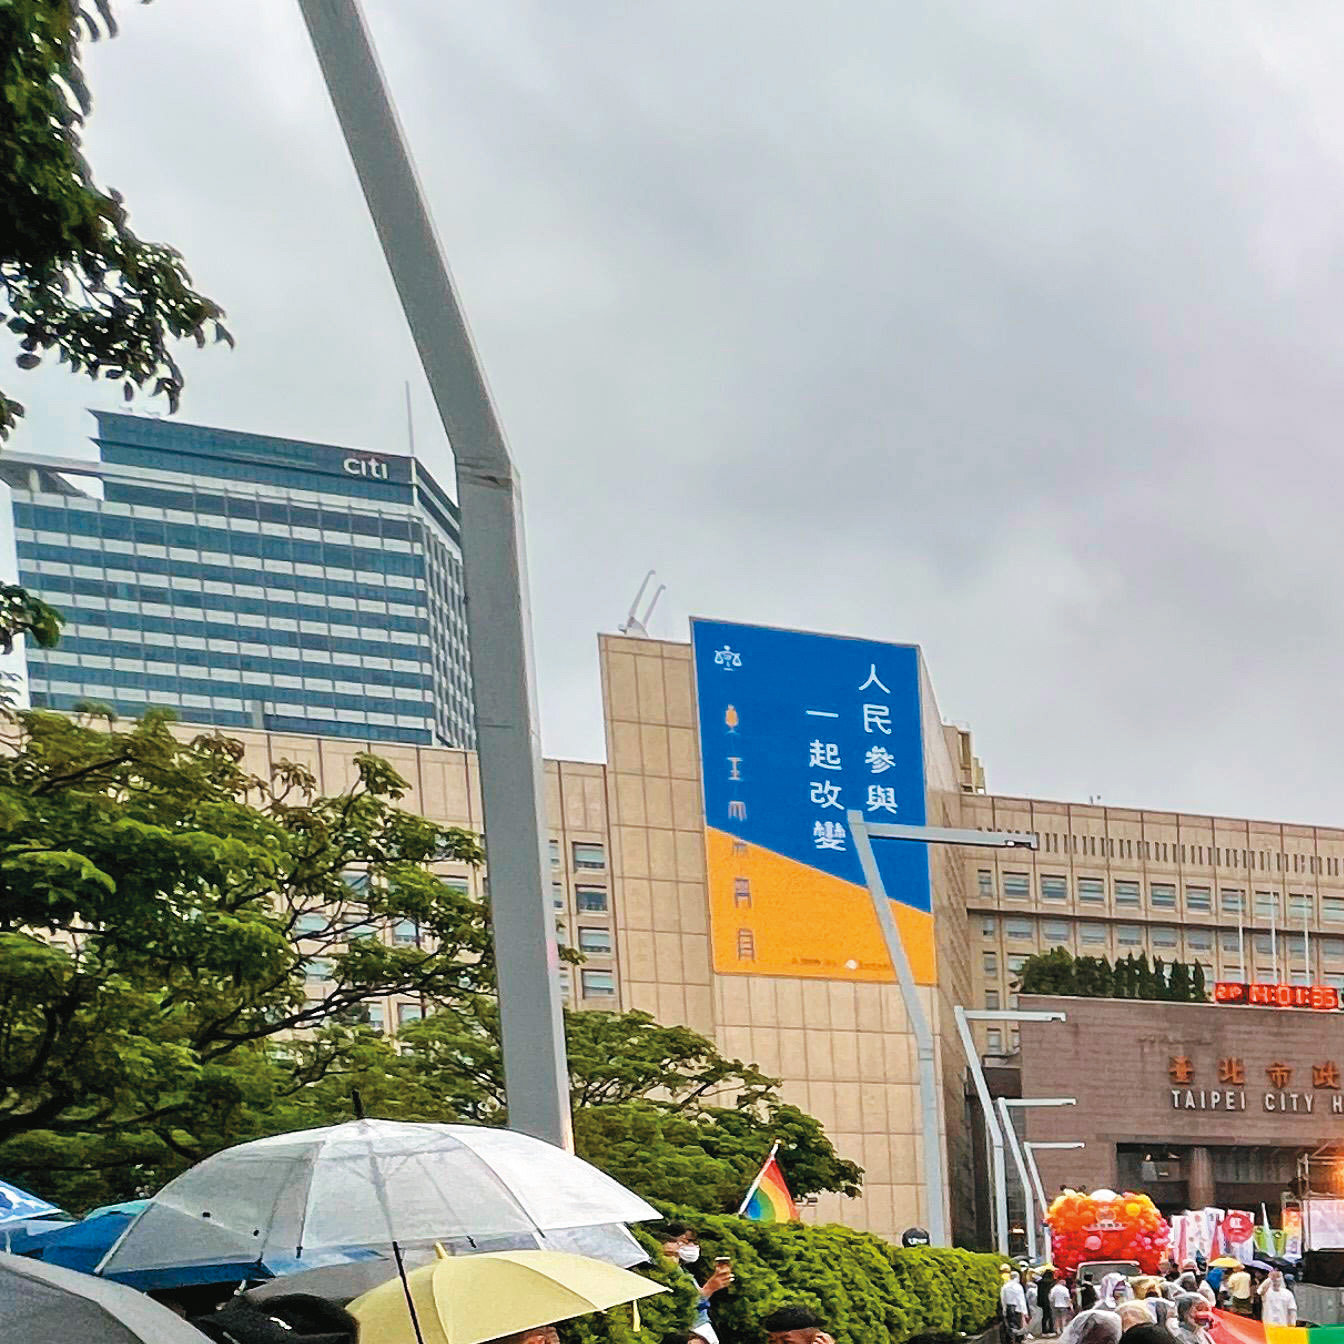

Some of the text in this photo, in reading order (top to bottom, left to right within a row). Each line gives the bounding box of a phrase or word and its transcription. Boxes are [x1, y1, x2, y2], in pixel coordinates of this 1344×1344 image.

[343, 457, 388, 480] citi
[859, 664, 897, 814] 人民參與
[805, 710, 847, 851] 一起改變
[1171, 1090, 1246, 1111] TAIPEI
[1264, 1093, 1314, 1113] CITY
